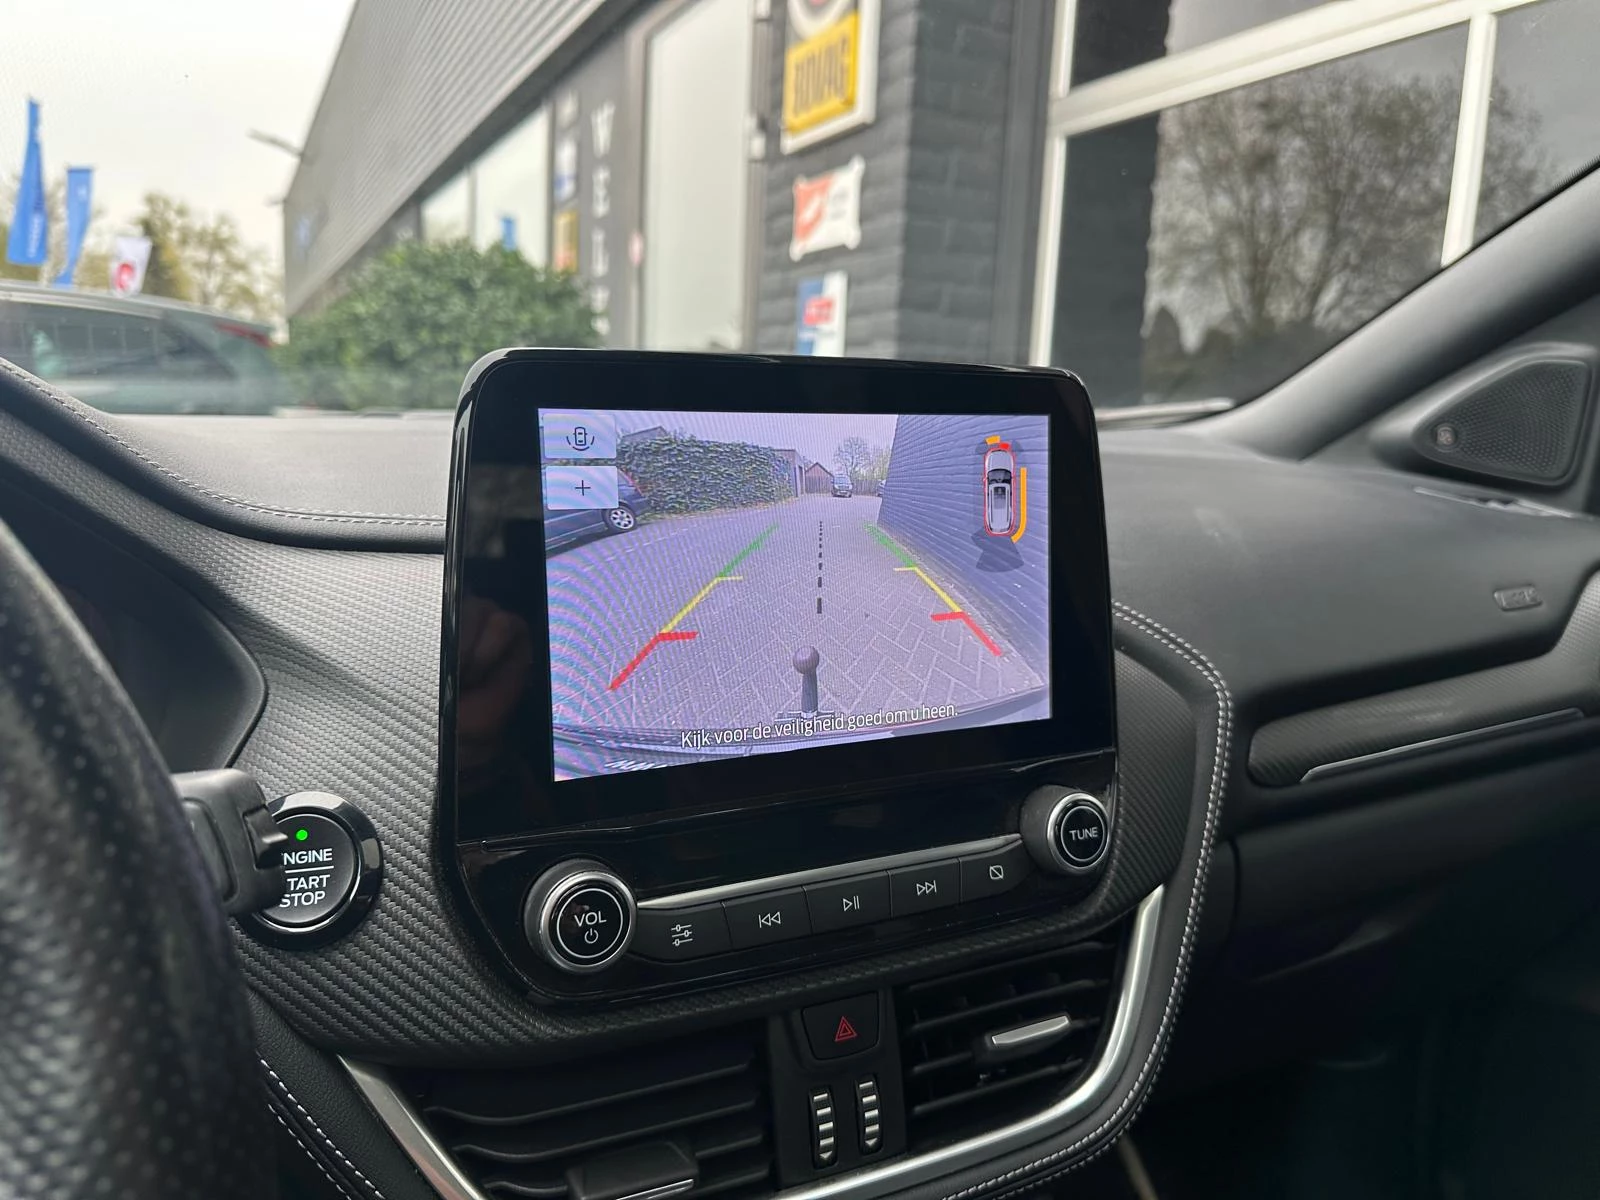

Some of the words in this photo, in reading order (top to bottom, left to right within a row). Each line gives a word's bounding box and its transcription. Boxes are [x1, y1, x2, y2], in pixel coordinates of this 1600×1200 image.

[681, 729, 711, 750] Kijk
[714, 727, 749, 744] voor
[752, 723, 771, 740] de
[775, 713, 844, 736] veiligheid
[847, 709, 882, 731] goed
[885, 709, 908, 723] om
[911, 709, 919, 721] u
[922, 704, 958, 720] heen.
[1069, 826, 1098, 841] TUNE
[281, 848, 333, 866] NGINE
[286, 874, 331, 891] TART
[279, 890, 326, 908] STOP
[574, 910, 607, 927] VOL
